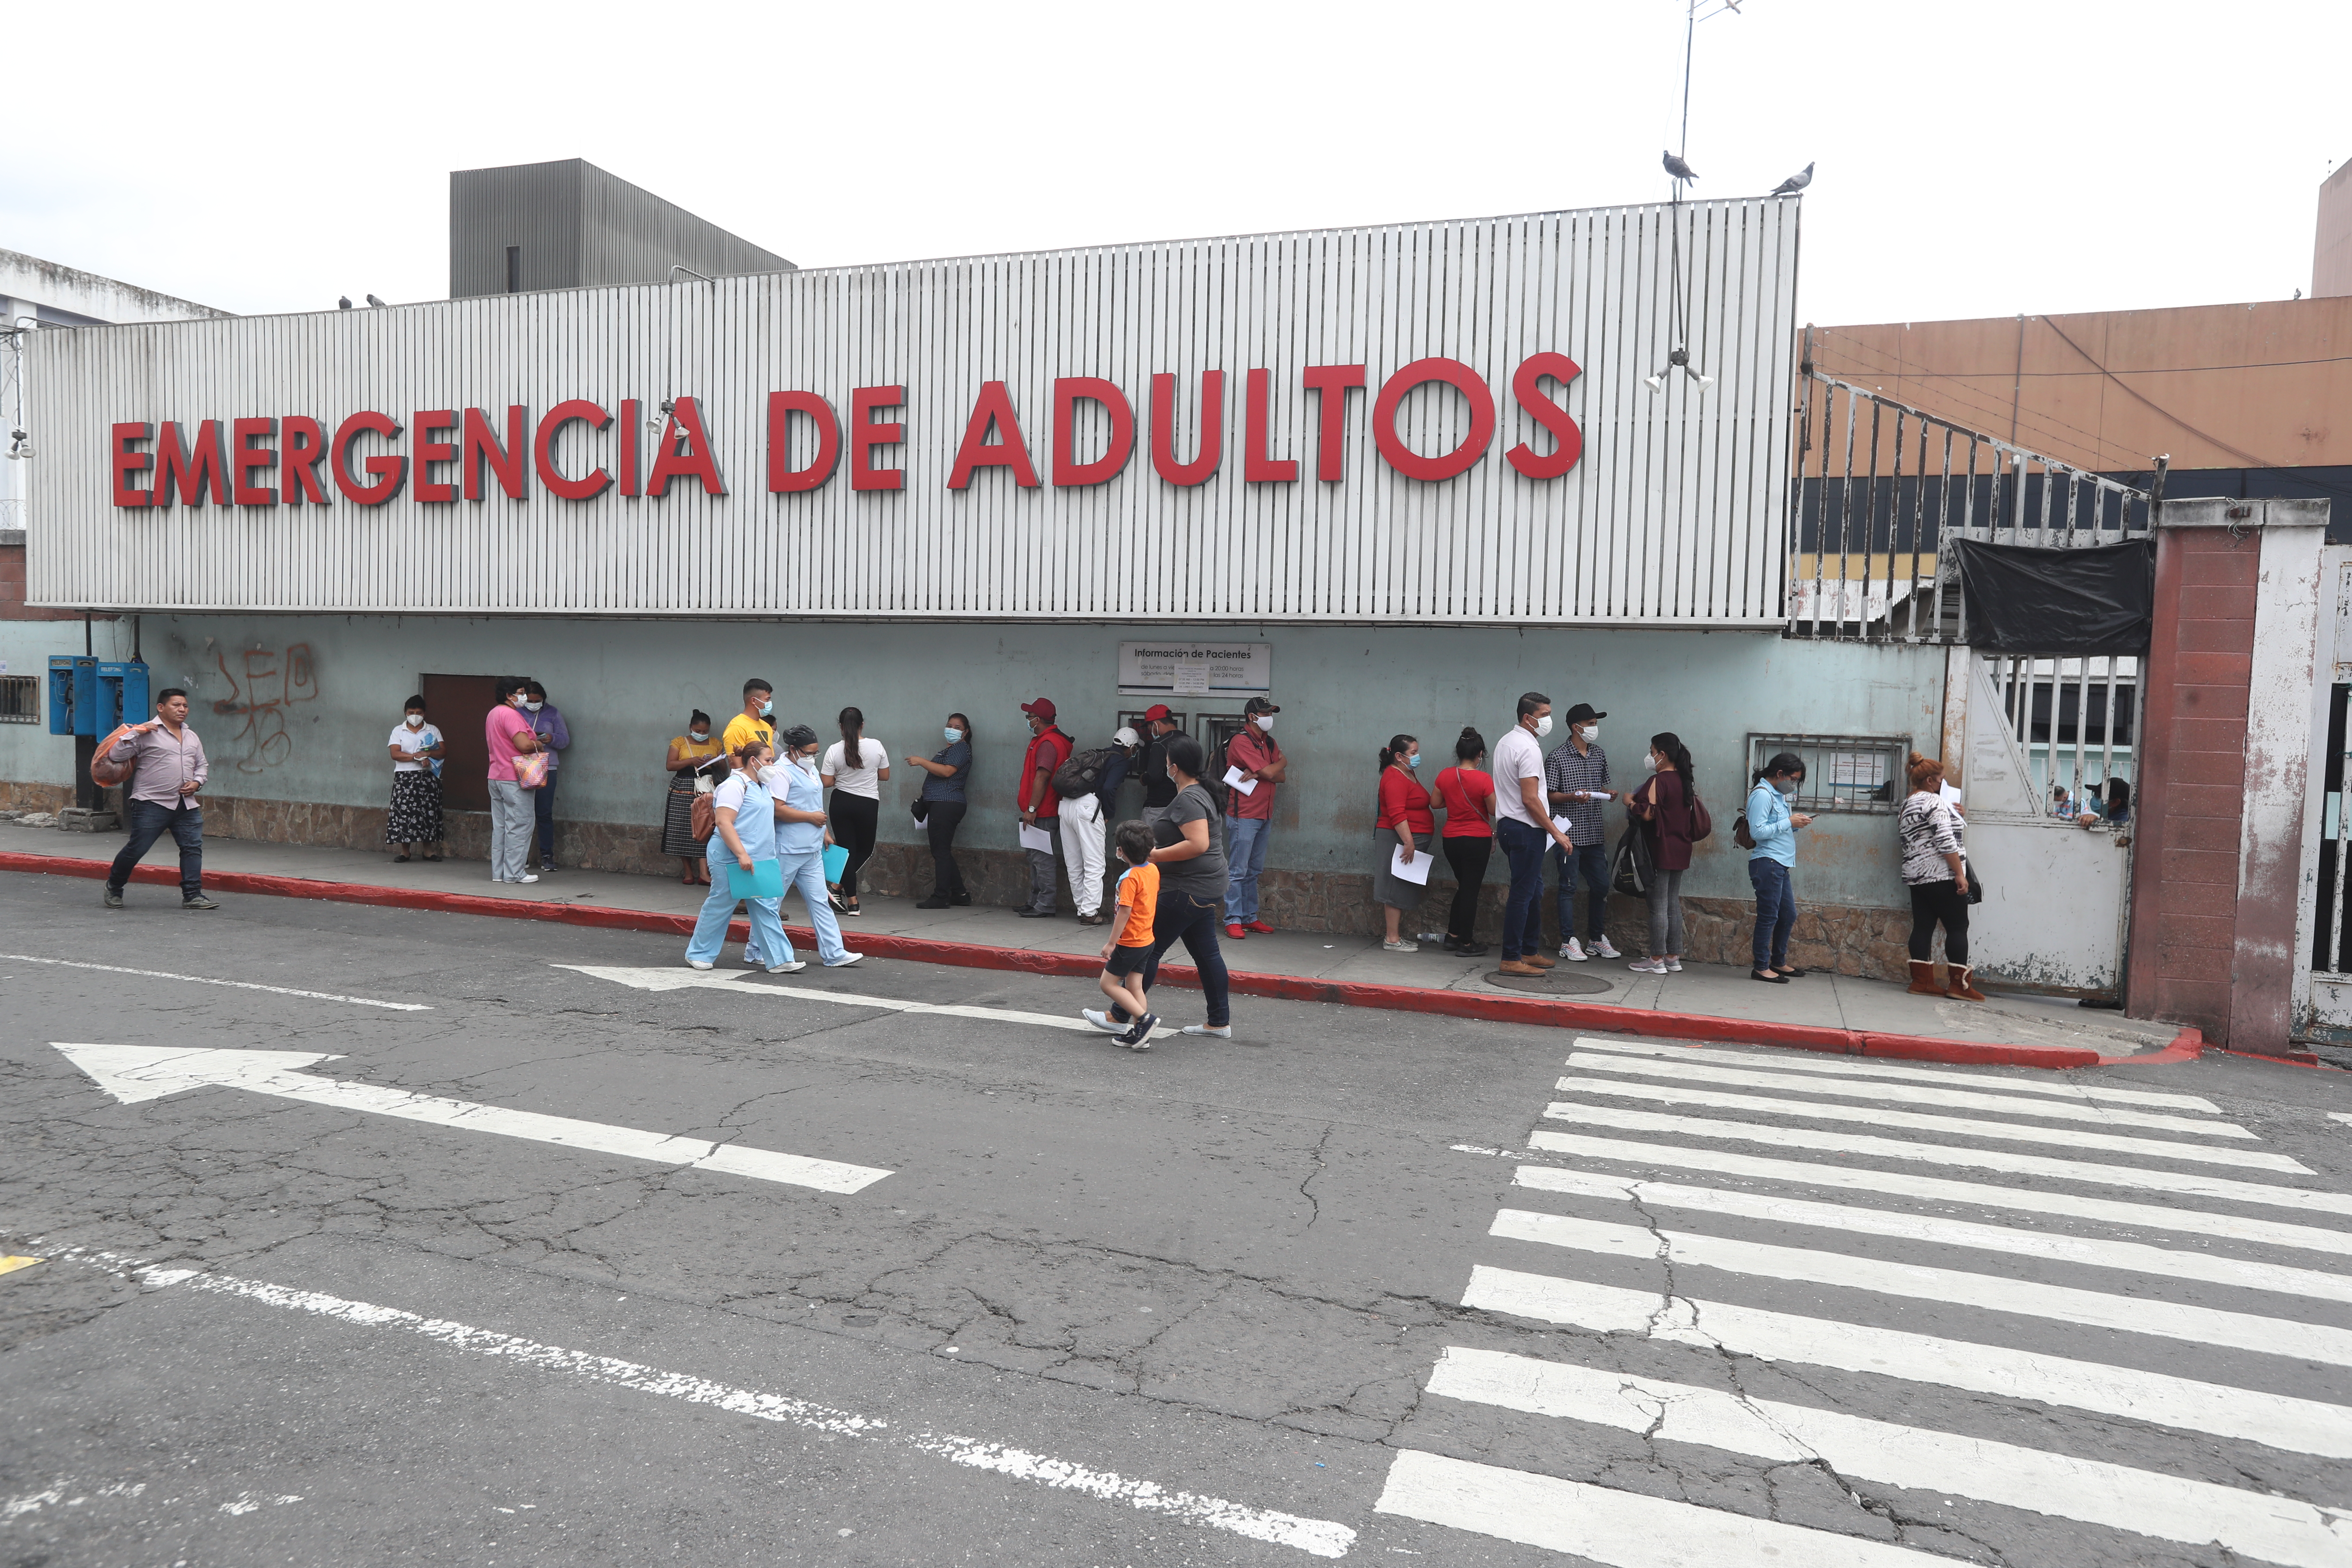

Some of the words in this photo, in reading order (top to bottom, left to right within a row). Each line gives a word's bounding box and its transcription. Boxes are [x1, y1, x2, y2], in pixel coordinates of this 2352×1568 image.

[112, 396, 729, 507] EMERGENCIA
[769, 384, 907, 493] DE
[947, 352, 1583, 489] ADULTOS
[1135, 648, 1188, 658] Información
[1191, 649, 1204, 658] de
[1207, 650, 1251, 659] Pacientes
